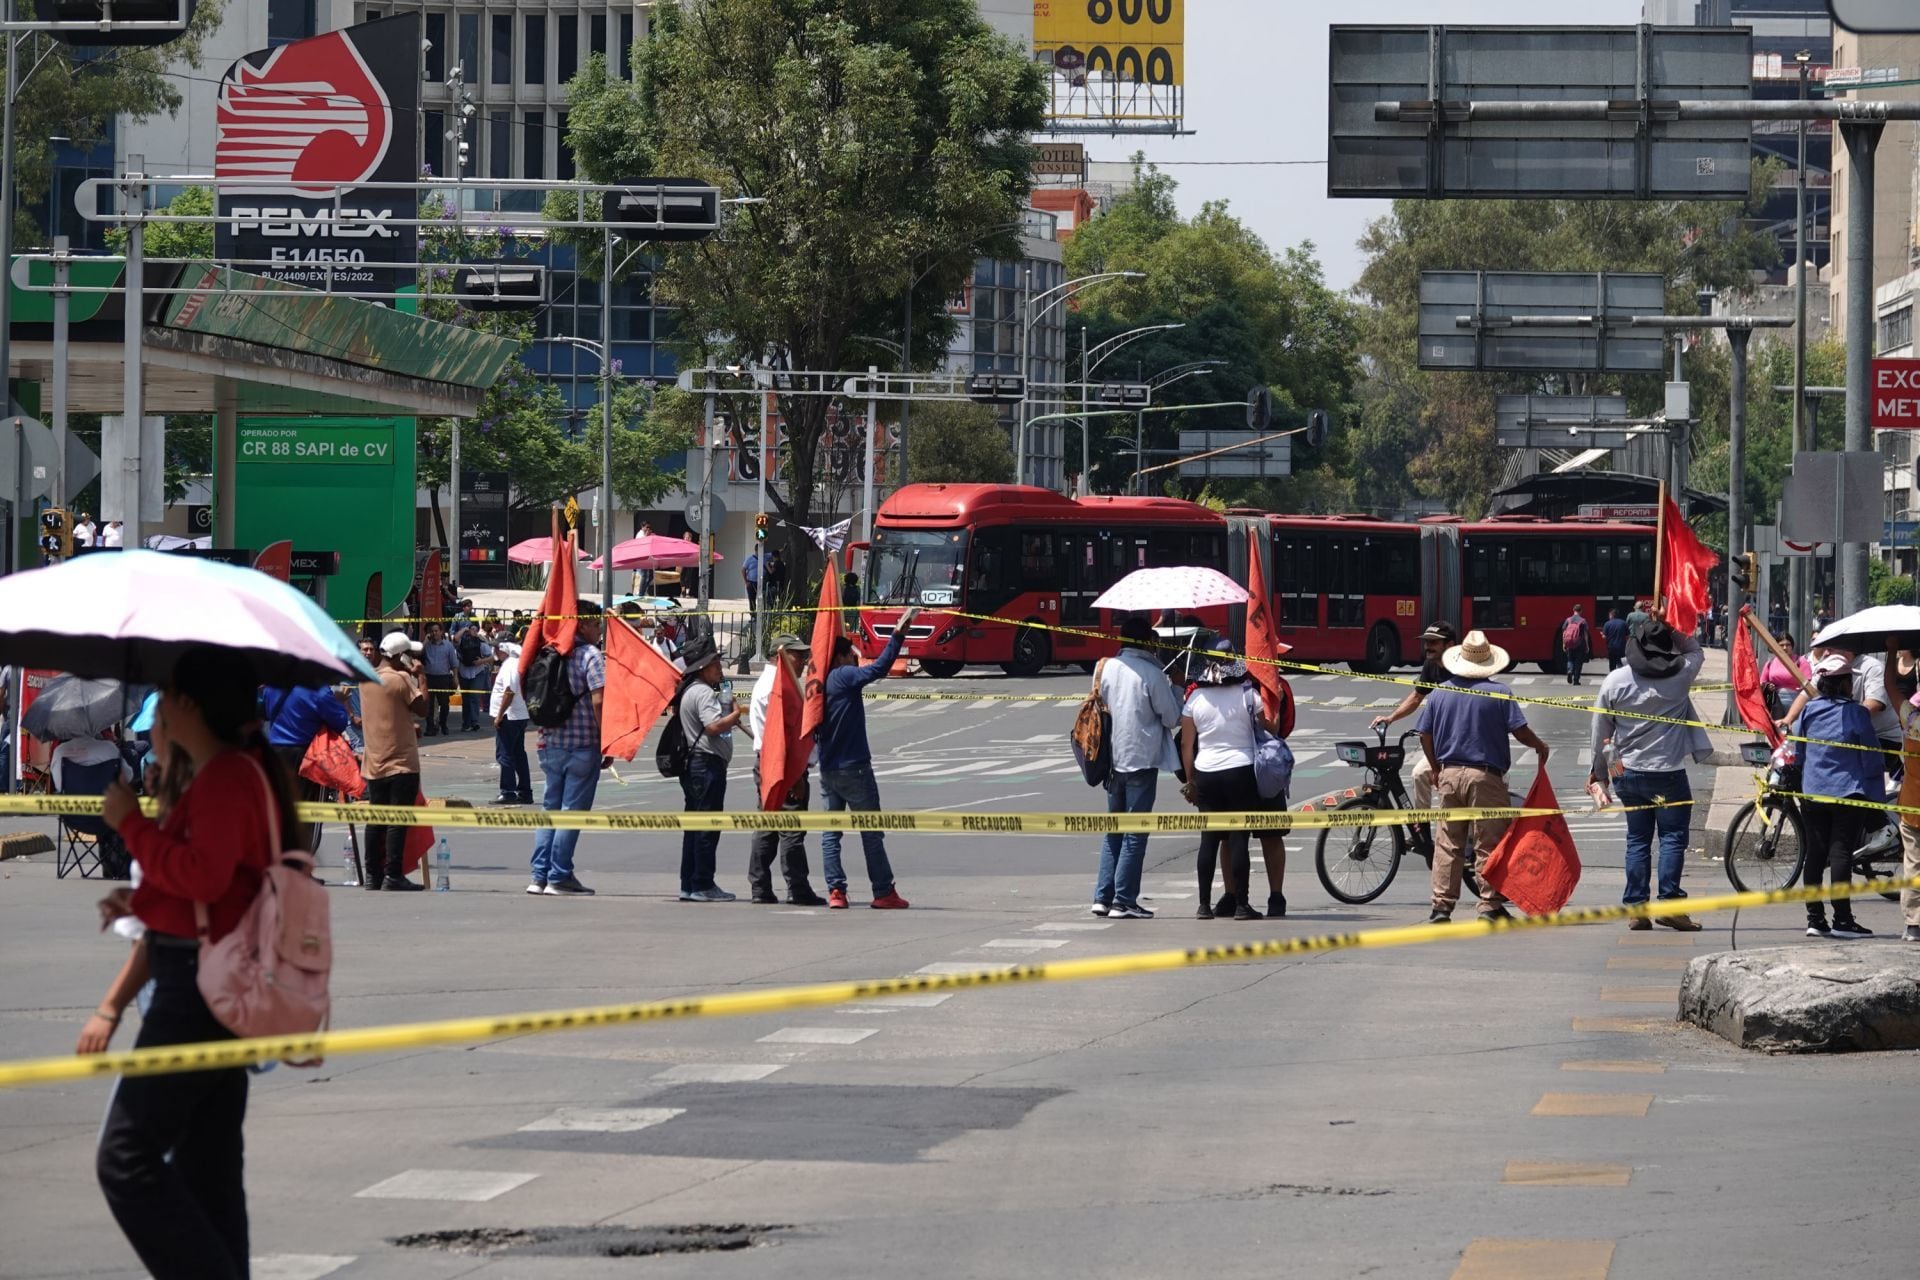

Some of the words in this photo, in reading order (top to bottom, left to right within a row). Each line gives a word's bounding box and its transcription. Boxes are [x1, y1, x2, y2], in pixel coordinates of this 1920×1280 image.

[1037, 146, 1079, 162] OTEL
[1037, 163, 1077, 172] ONSUL
[231, 207, 392, 238] PEMEX
[271, 247, 365, 271] E14550
[242, 441, 267, 456] CR
[271, 441, 290, 456] 88
[295, 442, 334, 456] SAPI
[339, 443, 359, 456] de
[364, 443, 388, 457] CV
[291, 559, 317, 568] MEX
[922, 592, 952, 602] 1071
[606, 815, 681, 829] PRECAUCION
[731, 815, 802, 829] PRECAUCION
[851, 815, 916, 830] PRECAUCION
[961, 816, 1022, 831] PRECAUCION
[1064, 816, 1119, 832] PRECAUCION
[1157, 815, 1208, 830] PRECAUCION
